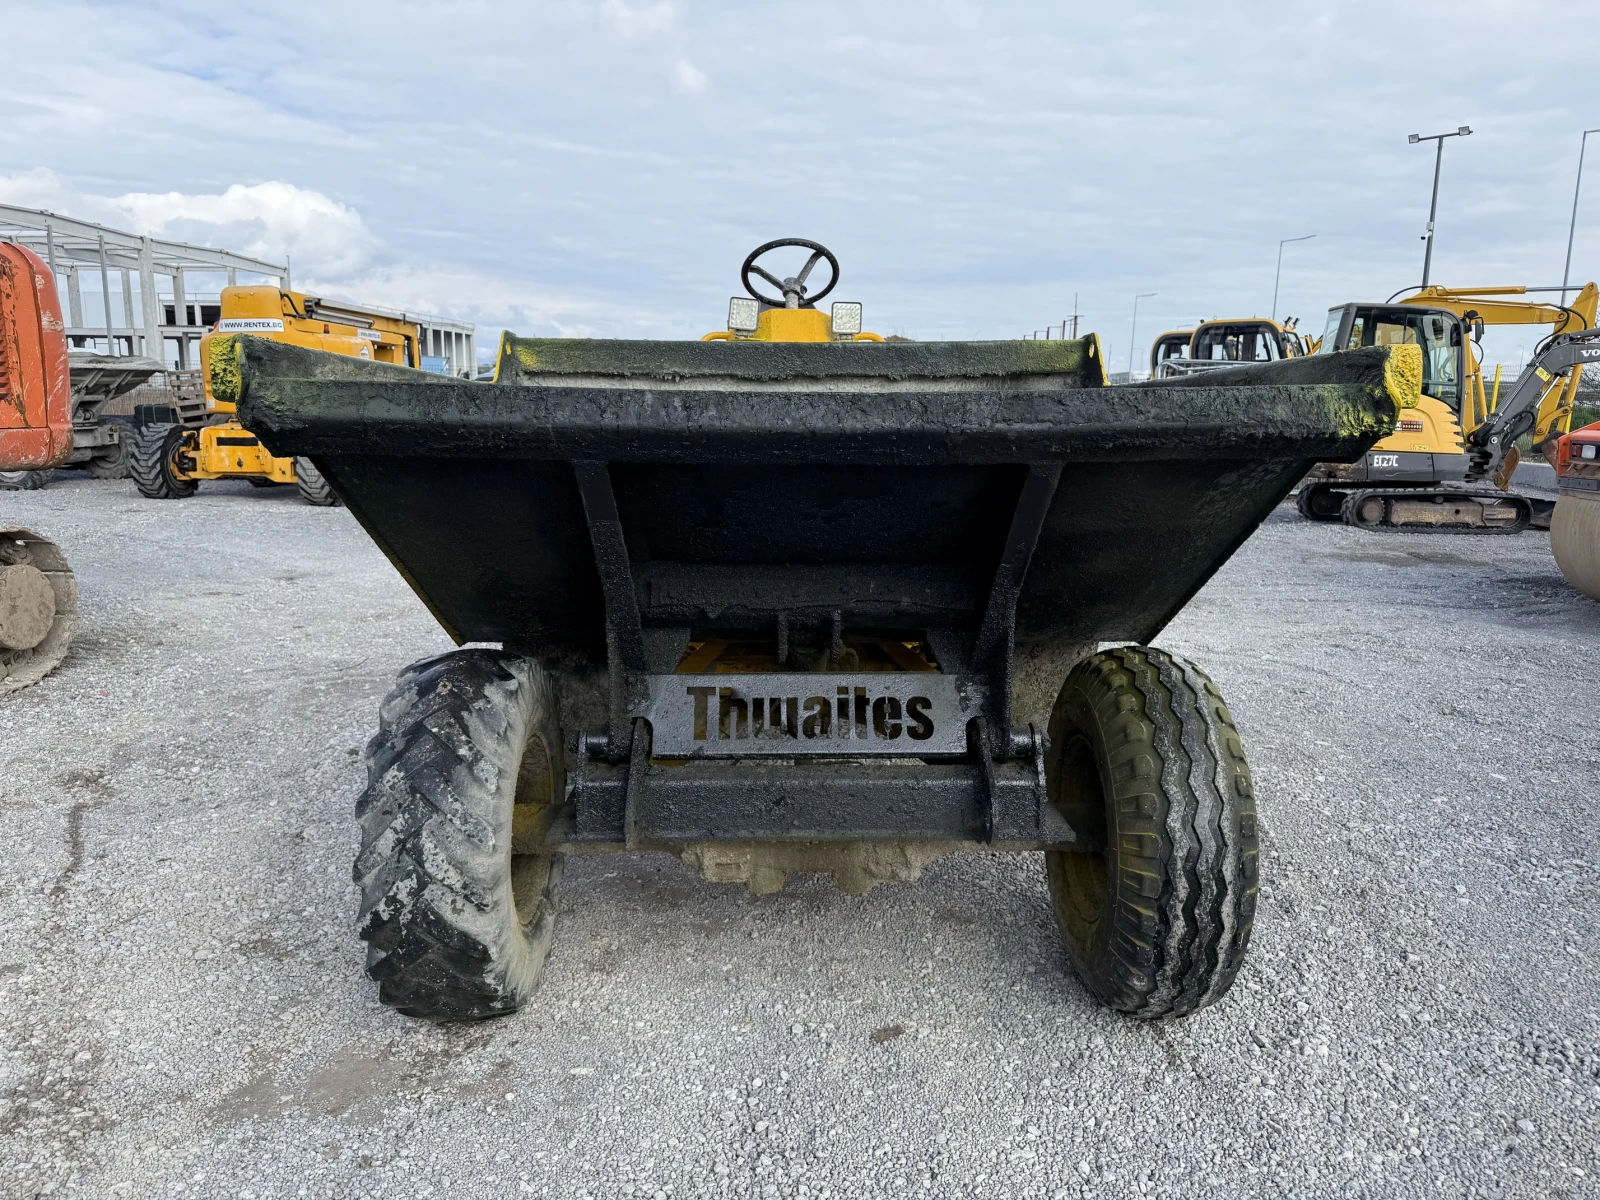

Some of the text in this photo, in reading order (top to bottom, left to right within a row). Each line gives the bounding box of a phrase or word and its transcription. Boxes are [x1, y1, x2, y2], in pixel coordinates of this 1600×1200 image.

[223, 321, 282, 329] WWW.RENTEX.BG
[1373, 454, 1399, 467] EC27C
[686, 686, 935, 741] Thwaites
